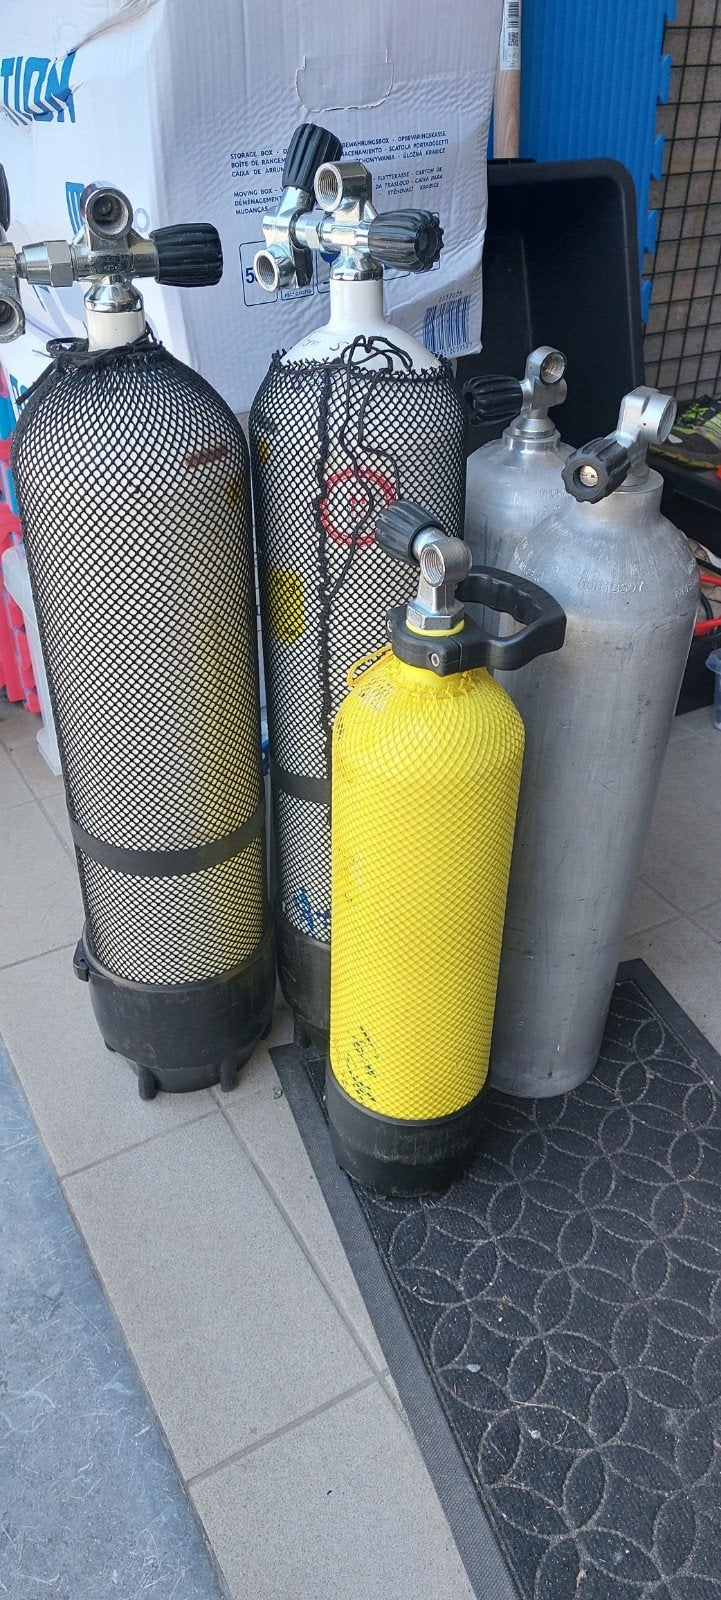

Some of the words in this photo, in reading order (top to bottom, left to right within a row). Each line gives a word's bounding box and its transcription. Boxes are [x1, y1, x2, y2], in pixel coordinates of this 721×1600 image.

[230, 151, 257, 160] STORAGE
[260, 149, 273, 157] BOX
[341, 137, 390, 149] BEWAHRUNGSBOX
[231, 160, 249, 169] BOÎTE
[261, 158, 286, 166] RANGEM
[341, 147, 383, 157] ACENAMIENTO
[388, 144, 411, 152] SCATOLA
[232, 170, 250, 178] CAIXA
[425, 147, 446, 156] KRABICE
[233, 189, 258, 198] MOVING
[377, 171, 410, 181] FLYTTEKASSE
[375, 182, 383, 190] DA
[384, 179, 410, 189] TRASLOCO
[414, 176, 429, 184] CAIXA
[430, 174, 443, 182] PARA
[235, 205, 268, 216] MUDANÇAS
[419, 183, 440, 191] KRABICE
